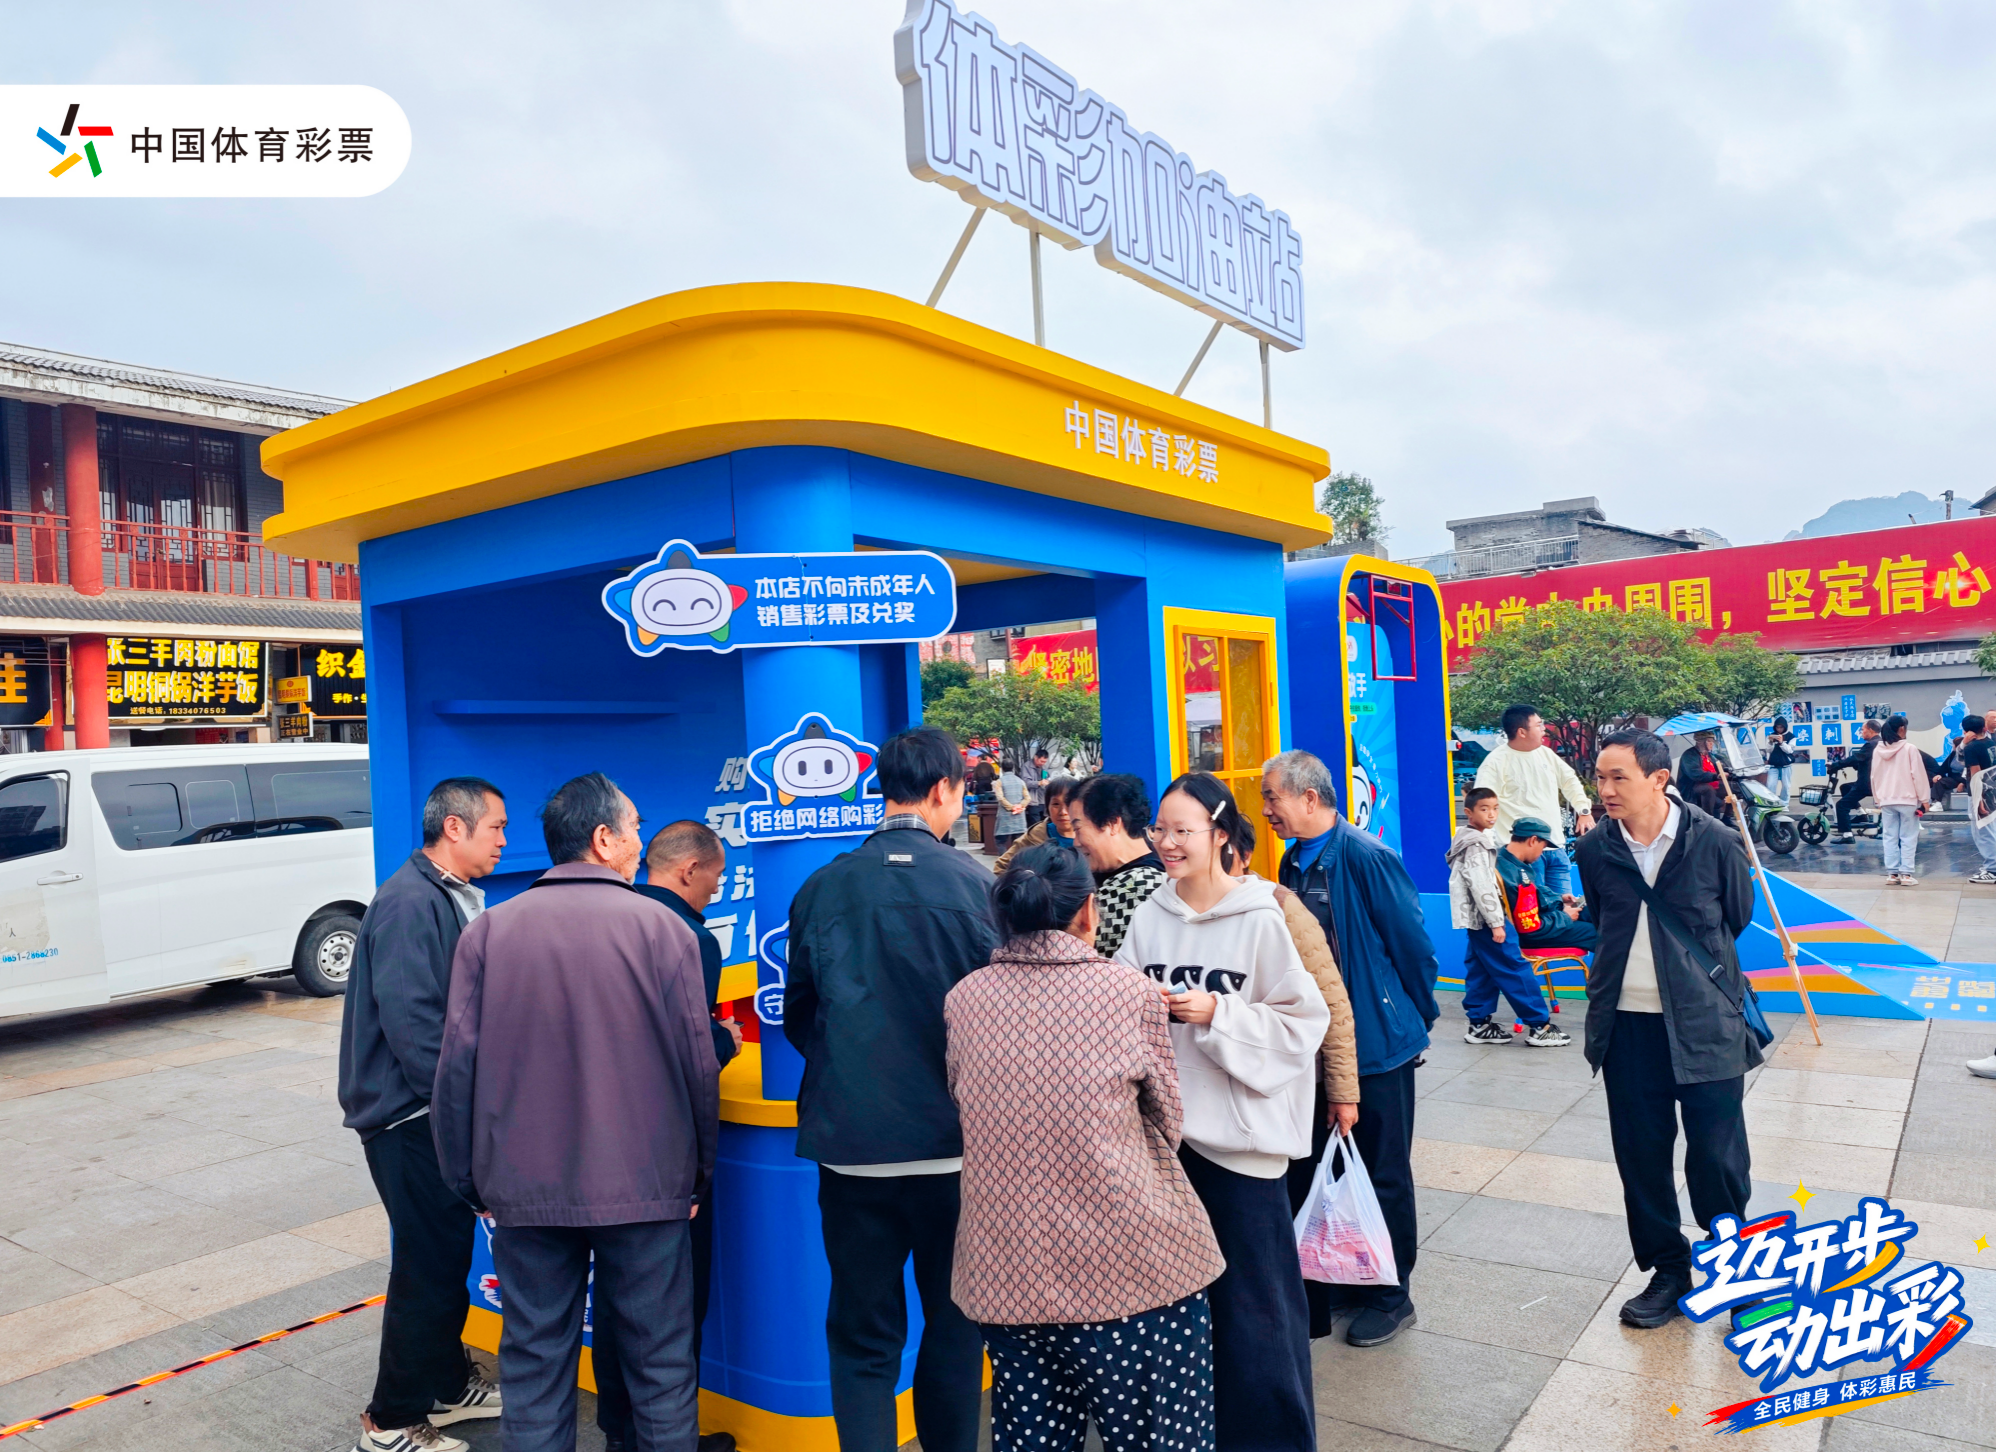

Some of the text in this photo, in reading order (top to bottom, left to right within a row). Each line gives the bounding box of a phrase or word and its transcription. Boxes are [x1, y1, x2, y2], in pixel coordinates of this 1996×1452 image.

[919, 0, 1304, 342] 体彩加油站
[1064, 400, 1219, 484] 中国体育彩票
[755, 574, 936, 599] 本店不向未成年人
[757, 602, 916, 627] 销售彩票及兑奖
[106, 637, 260, 669] 张三羊肉粉面馆
[316, 649, 366, 679] 织金
[106, 671, 259, 704] 昆明铜锅洋芋饭
[750, 803, 884, 832] 拒绝网络购彩
